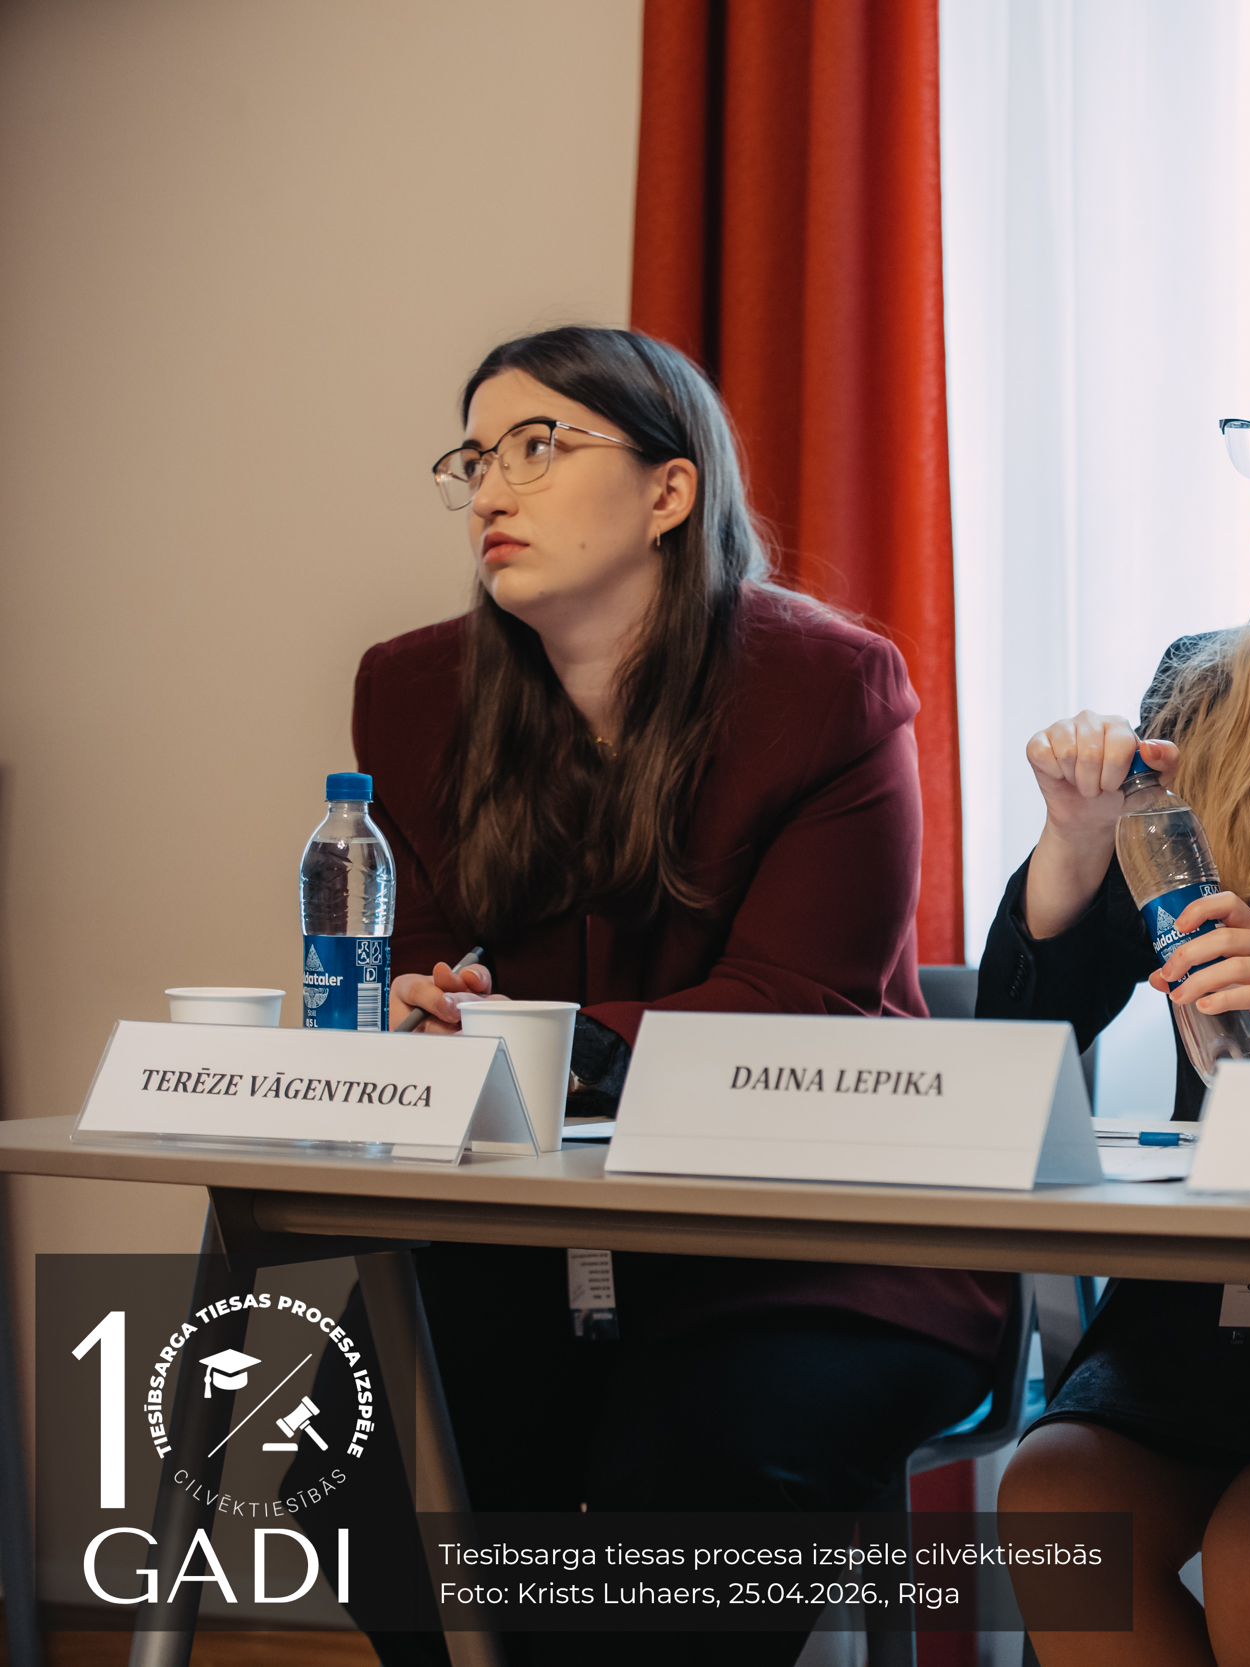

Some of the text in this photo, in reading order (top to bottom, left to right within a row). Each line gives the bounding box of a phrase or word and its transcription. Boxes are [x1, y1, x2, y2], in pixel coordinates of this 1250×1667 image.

[141, 1068, 432, 1108] TERĒZE VĀGENTROCA
[730, 1065, 943, 1097] DAINA LEPIKA
